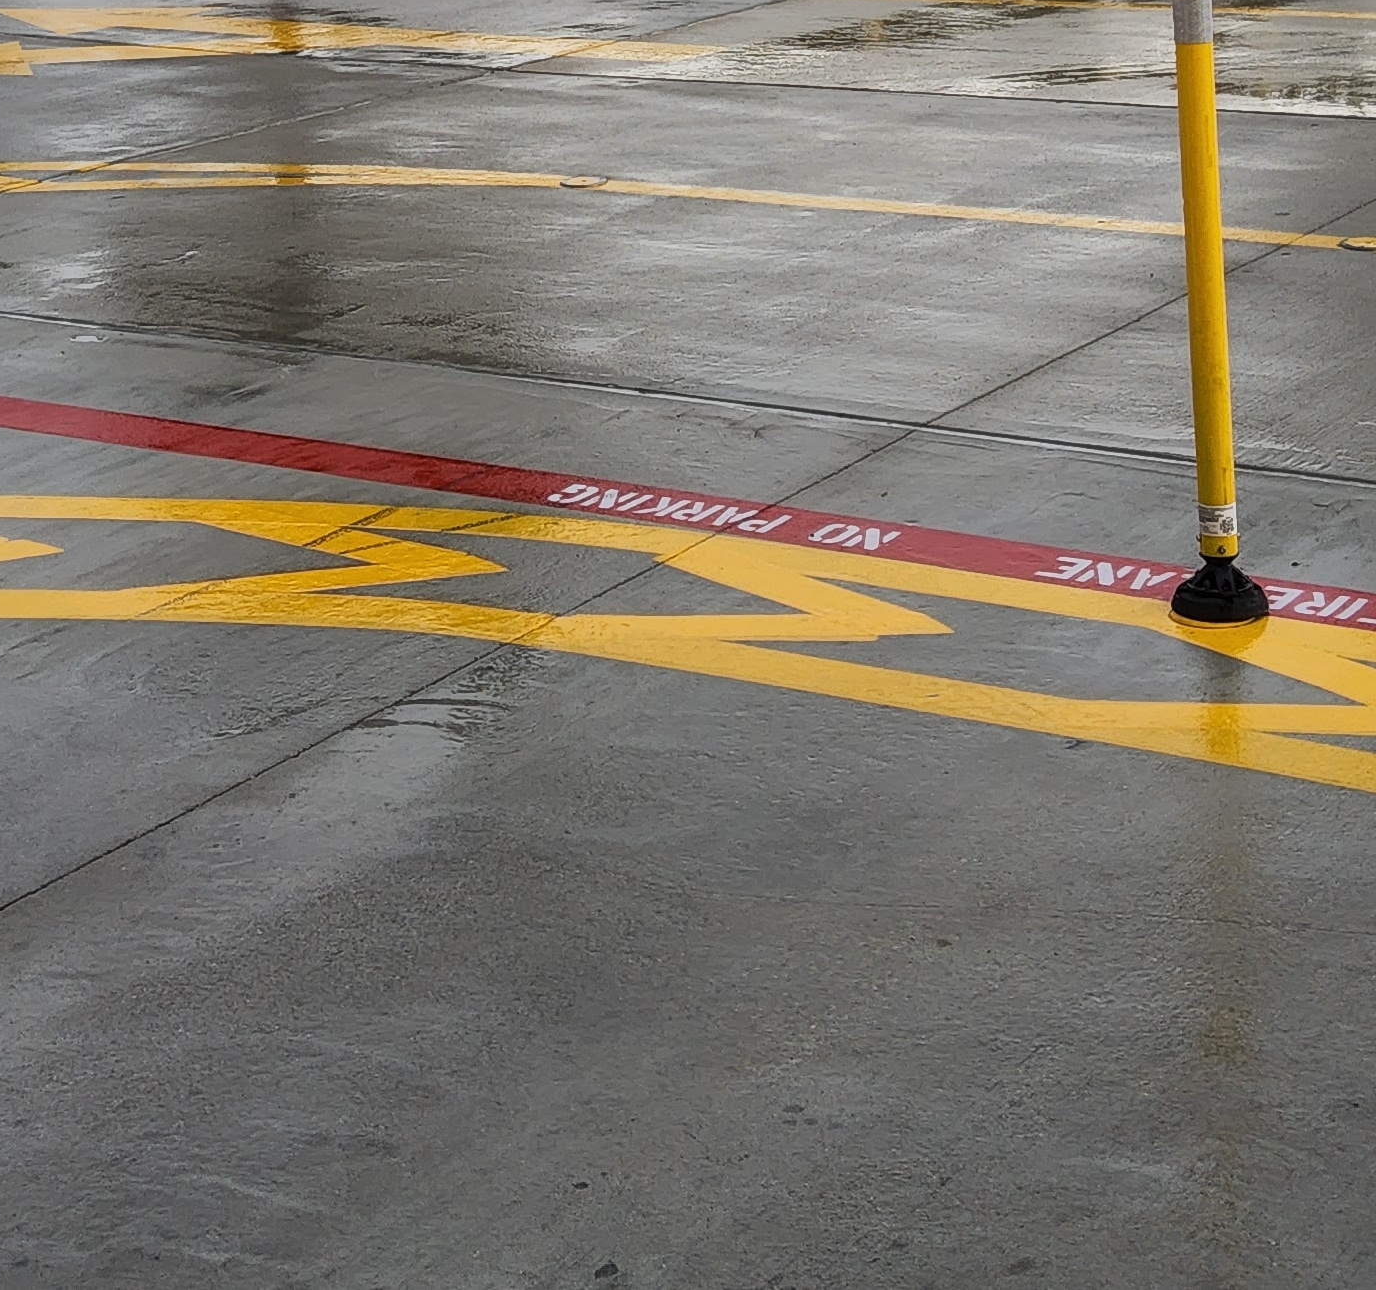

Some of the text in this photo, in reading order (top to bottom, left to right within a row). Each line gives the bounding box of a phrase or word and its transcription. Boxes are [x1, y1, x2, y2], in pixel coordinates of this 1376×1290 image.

[547, 484, 792, 533] PARKING
[808, 523, 901, 551] NO
[1034, 556, 1195, 590] ANE
